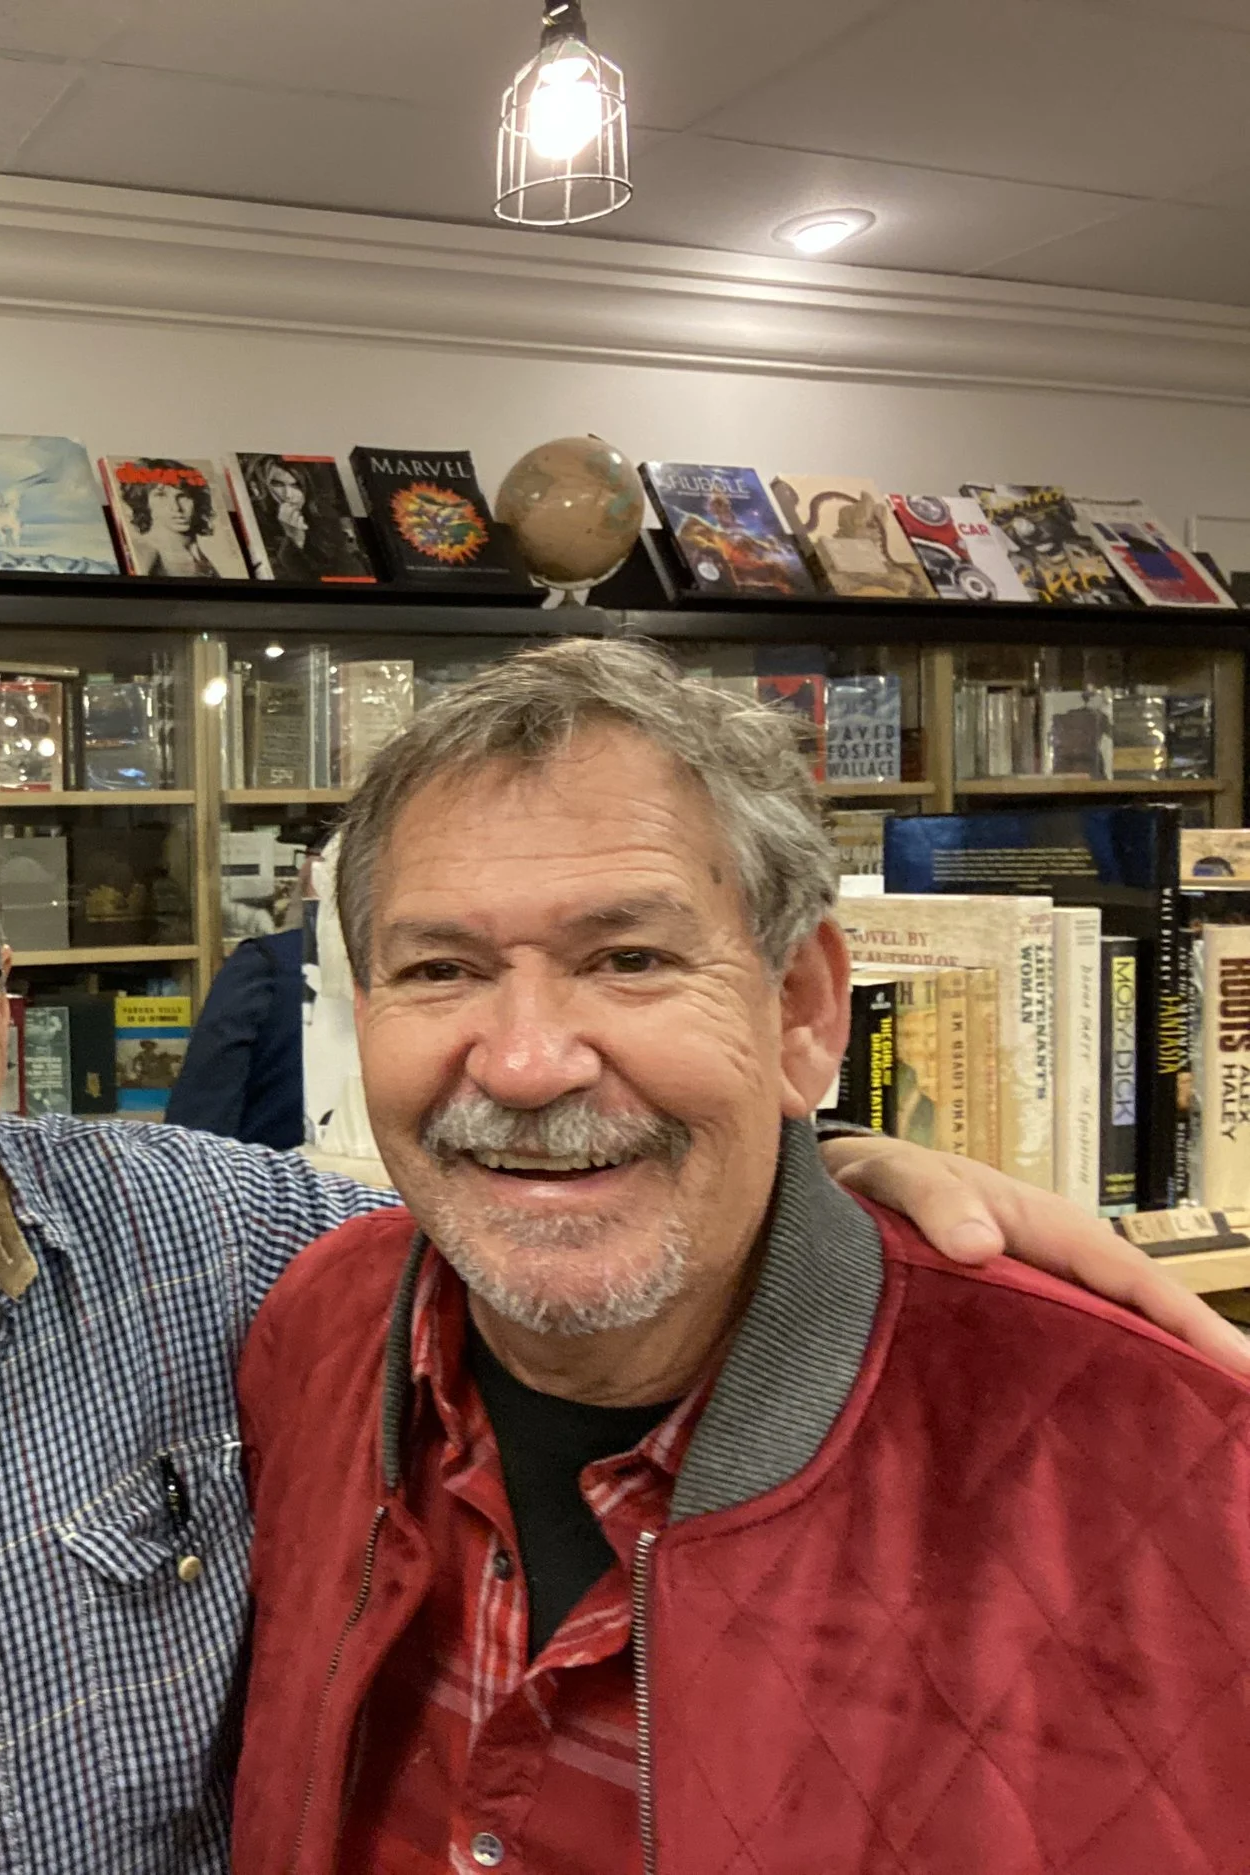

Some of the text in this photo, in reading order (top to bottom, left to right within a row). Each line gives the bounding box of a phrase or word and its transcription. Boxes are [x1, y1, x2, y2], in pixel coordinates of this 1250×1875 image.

[371, 457, 471, 479] MARVEL
[958, 523, 991, 537] CAR
[828, 725, 894, 741] DAVID
[828, 742, 894, 759] FOSTER
[828, 761, 895, 777] WALLACE
[907, 932, 929, 947] BY
[1020, 946, 1034, 1024] WOMAN
[1219, 958, 1250, 1053] ROOTS
[880, 1016, 893, 1039] THE
[951, 1011, 964, 1032] ME
[1034, 944, 1046, 1100] LIEUTENANT'S
[1157, 995, 1182, 1074] FANTASIA
[870, 1032, 883, 1088] DRAGON
[880, 1040, 893, 1068] GIRL
[951, 1040, 964, 1089] LOVED
[1221, 1063, 1236, 1143] HALEY
[1239, 1065, 1250, 1125] ALEX
[951, 1099, 964, 1133] WHO
